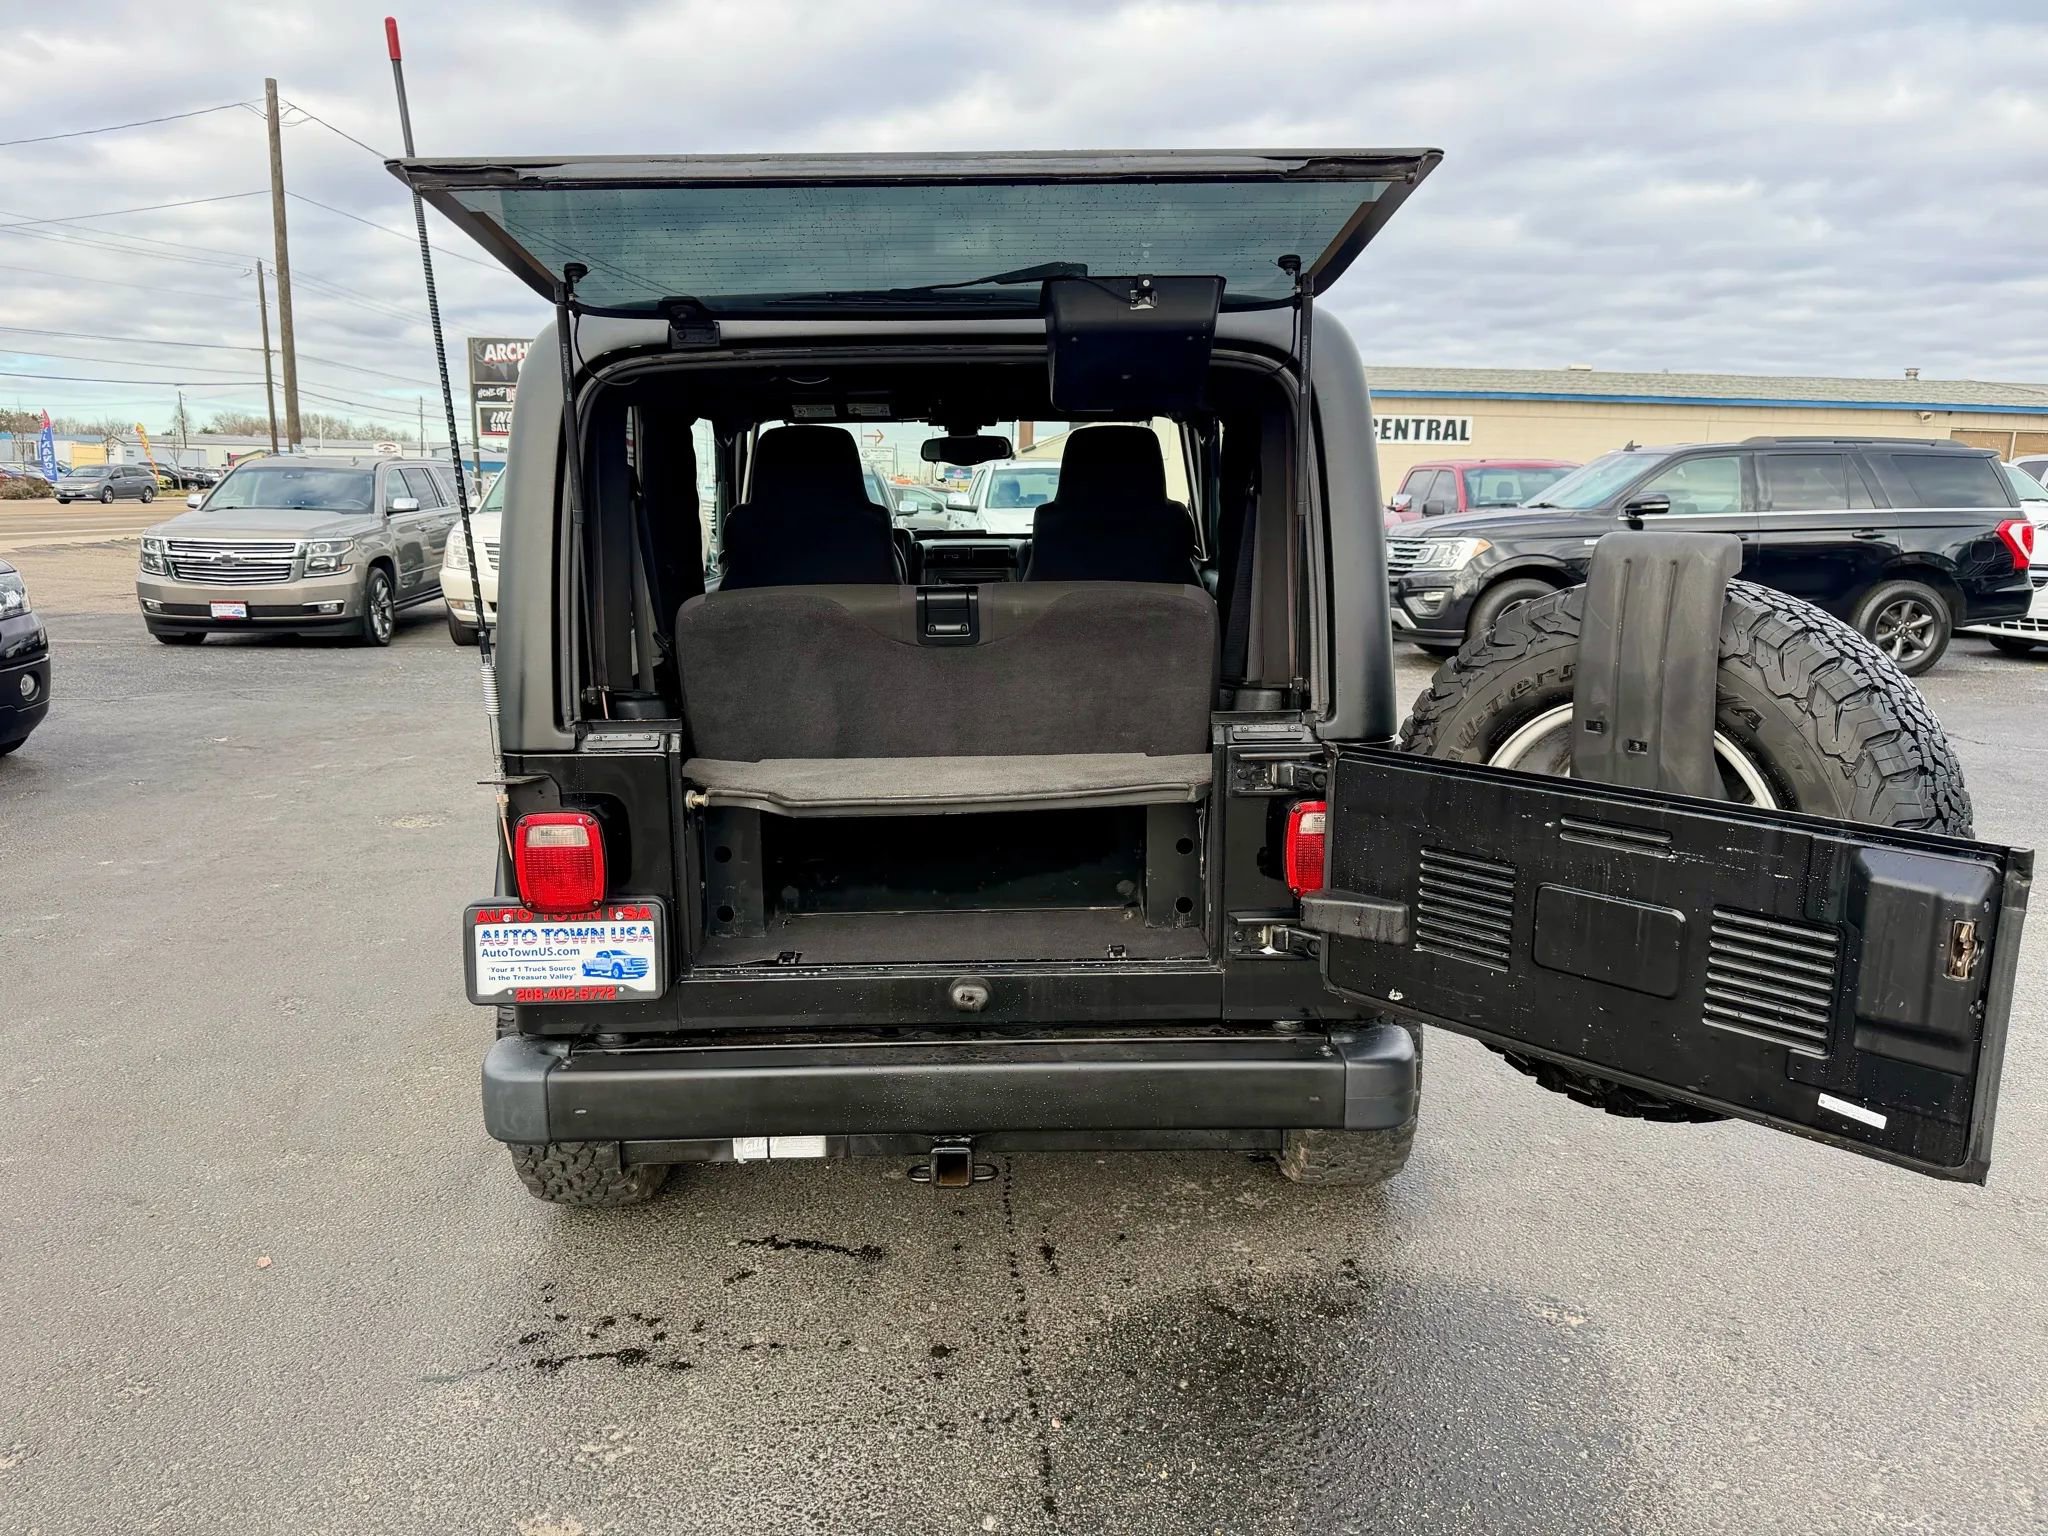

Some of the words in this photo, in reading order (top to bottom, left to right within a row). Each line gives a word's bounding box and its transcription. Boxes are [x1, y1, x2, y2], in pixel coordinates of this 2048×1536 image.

[476, 908, 534, 923] AUTO
[608, 905, 653, 921] USA
[480, 928, 538, 946] AUTO
[541, 926, 606, 945] TOWN
[611, 926, 653, 943] USA
[481, 946, 580, 957] AutoTownUS.com
